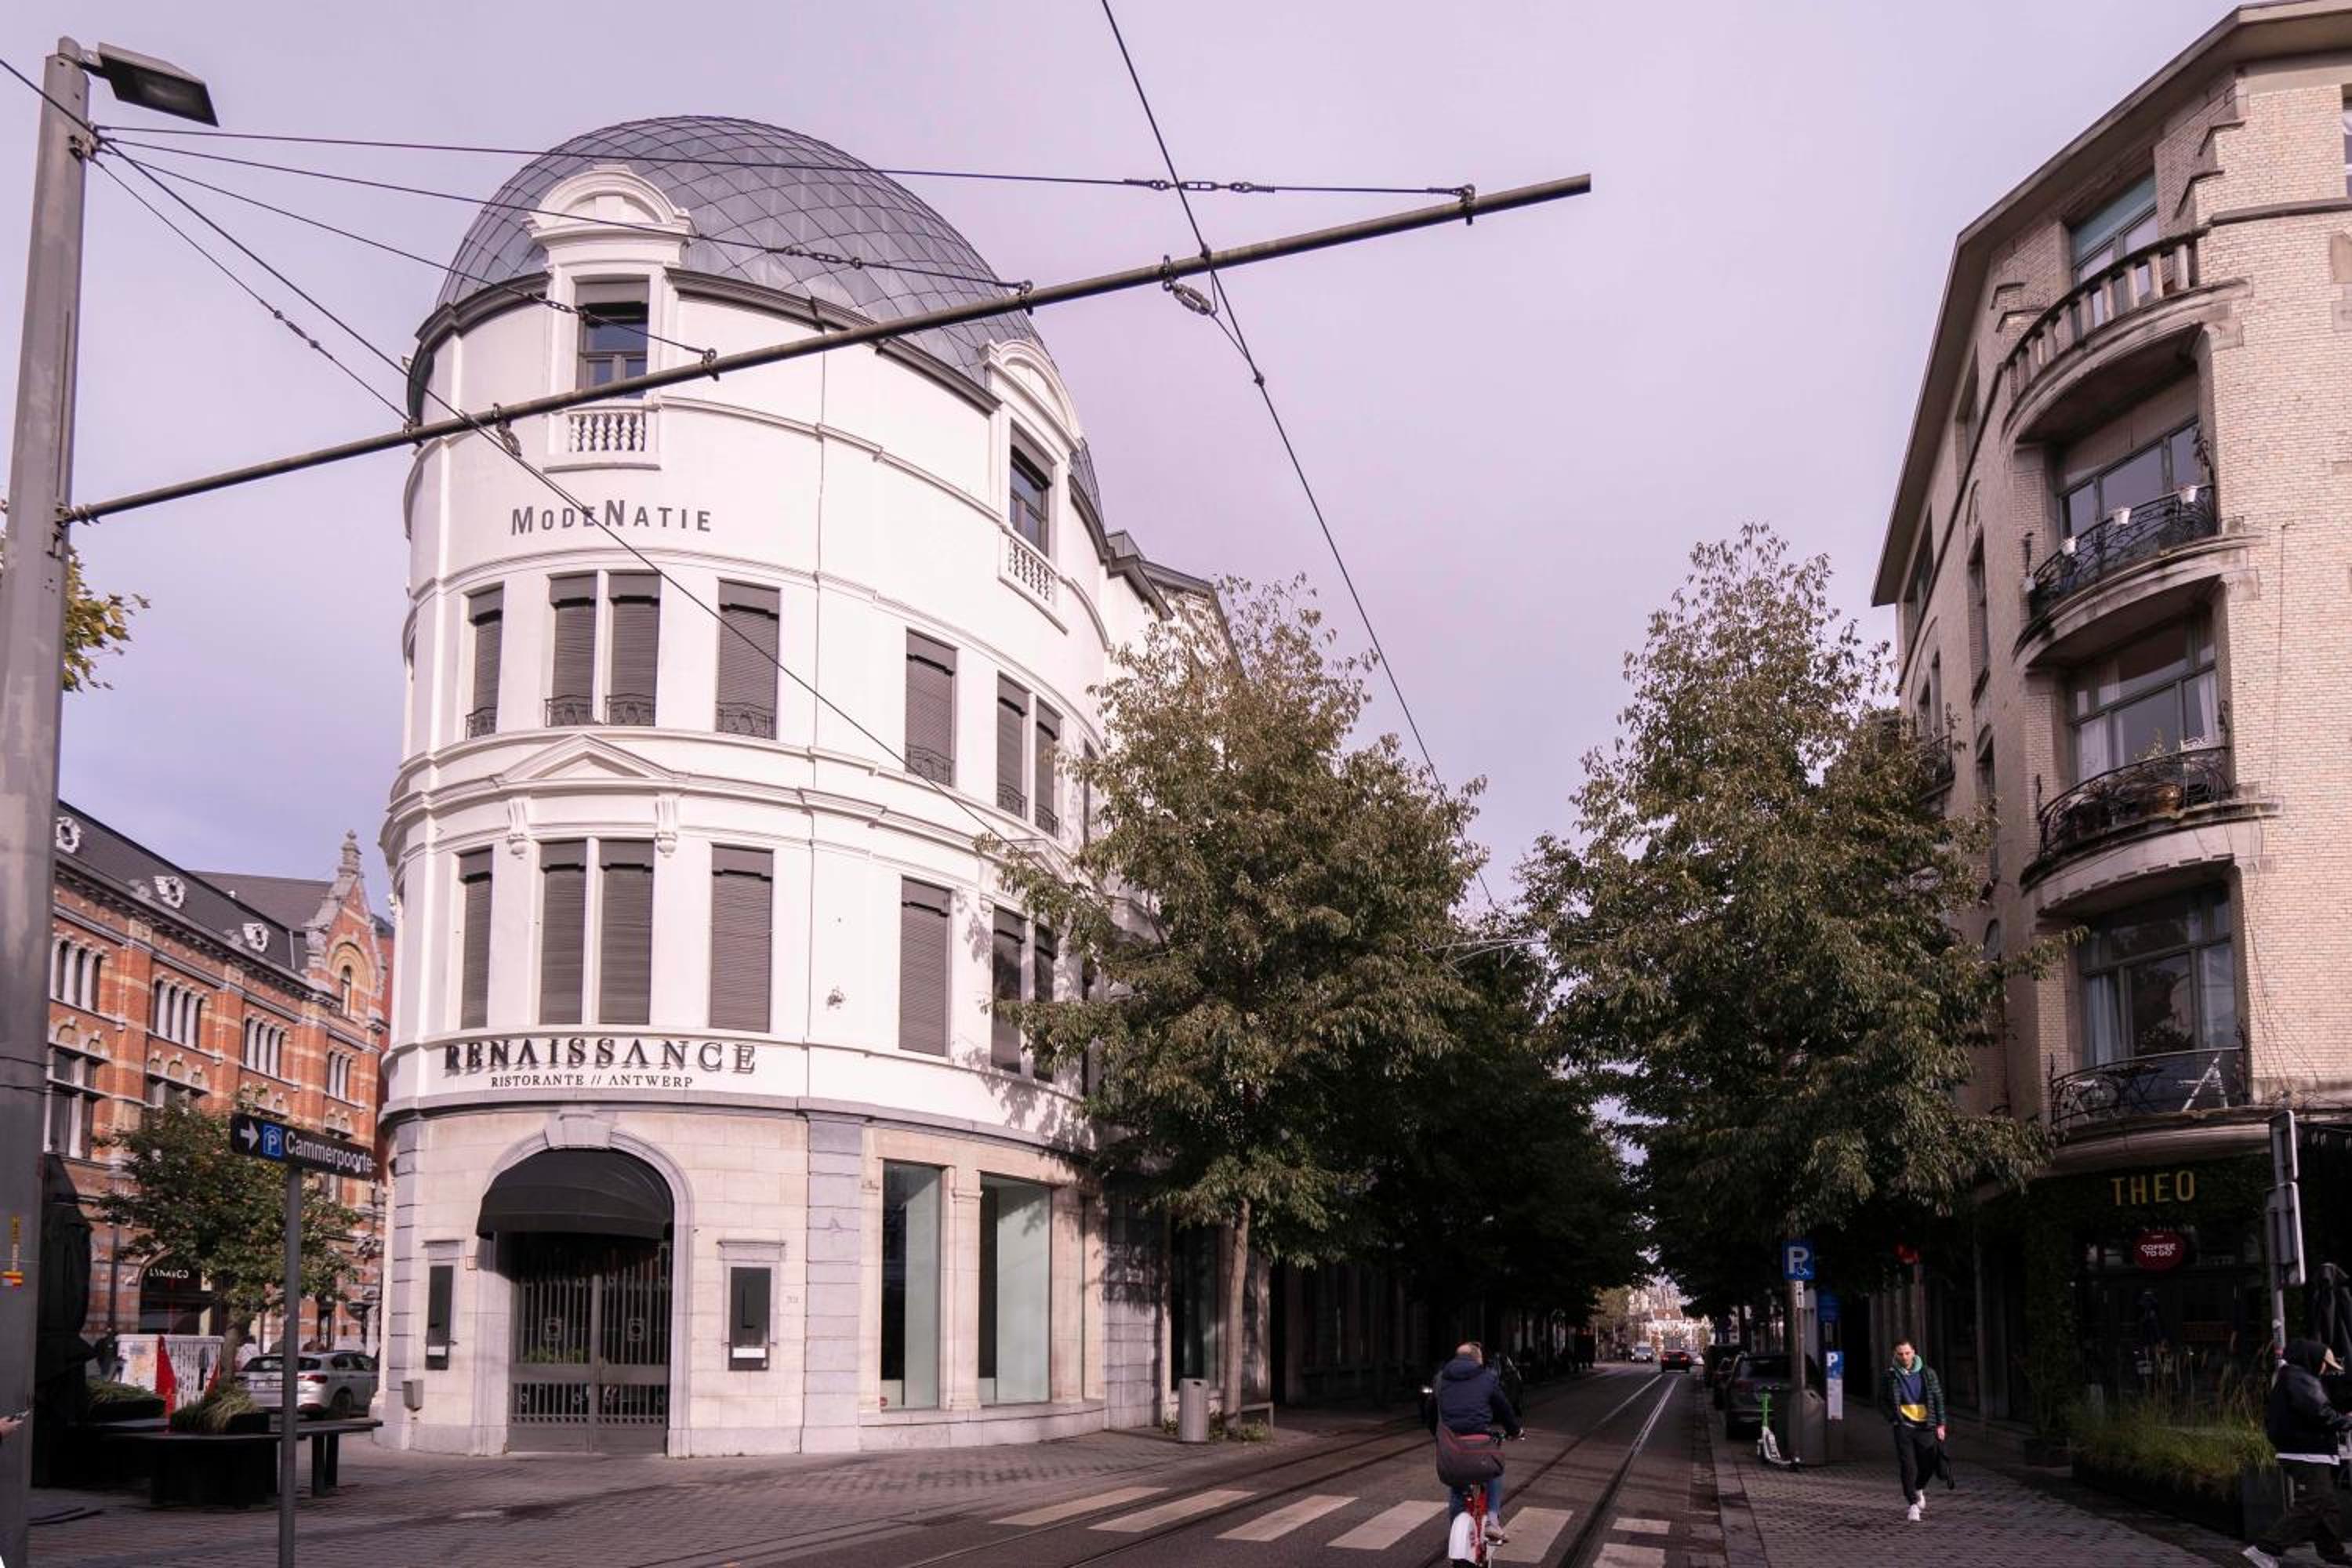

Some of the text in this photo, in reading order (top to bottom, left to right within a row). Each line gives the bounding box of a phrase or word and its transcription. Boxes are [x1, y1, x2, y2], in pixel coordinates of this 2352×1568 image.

[445, 1037, 755, 1073] RENAISSANCE
[491, 1074, 585, 1087] RISTORANTE
[608, 1075, 693, 1087] ANTWERP
[2110, 1170, 2195, 1206] THEO
[2140, 1243, 2176, 1252] COFFEE
[1788, 1247, 1809, 1274] P
[1827, 1352, 1838, 1367] P
